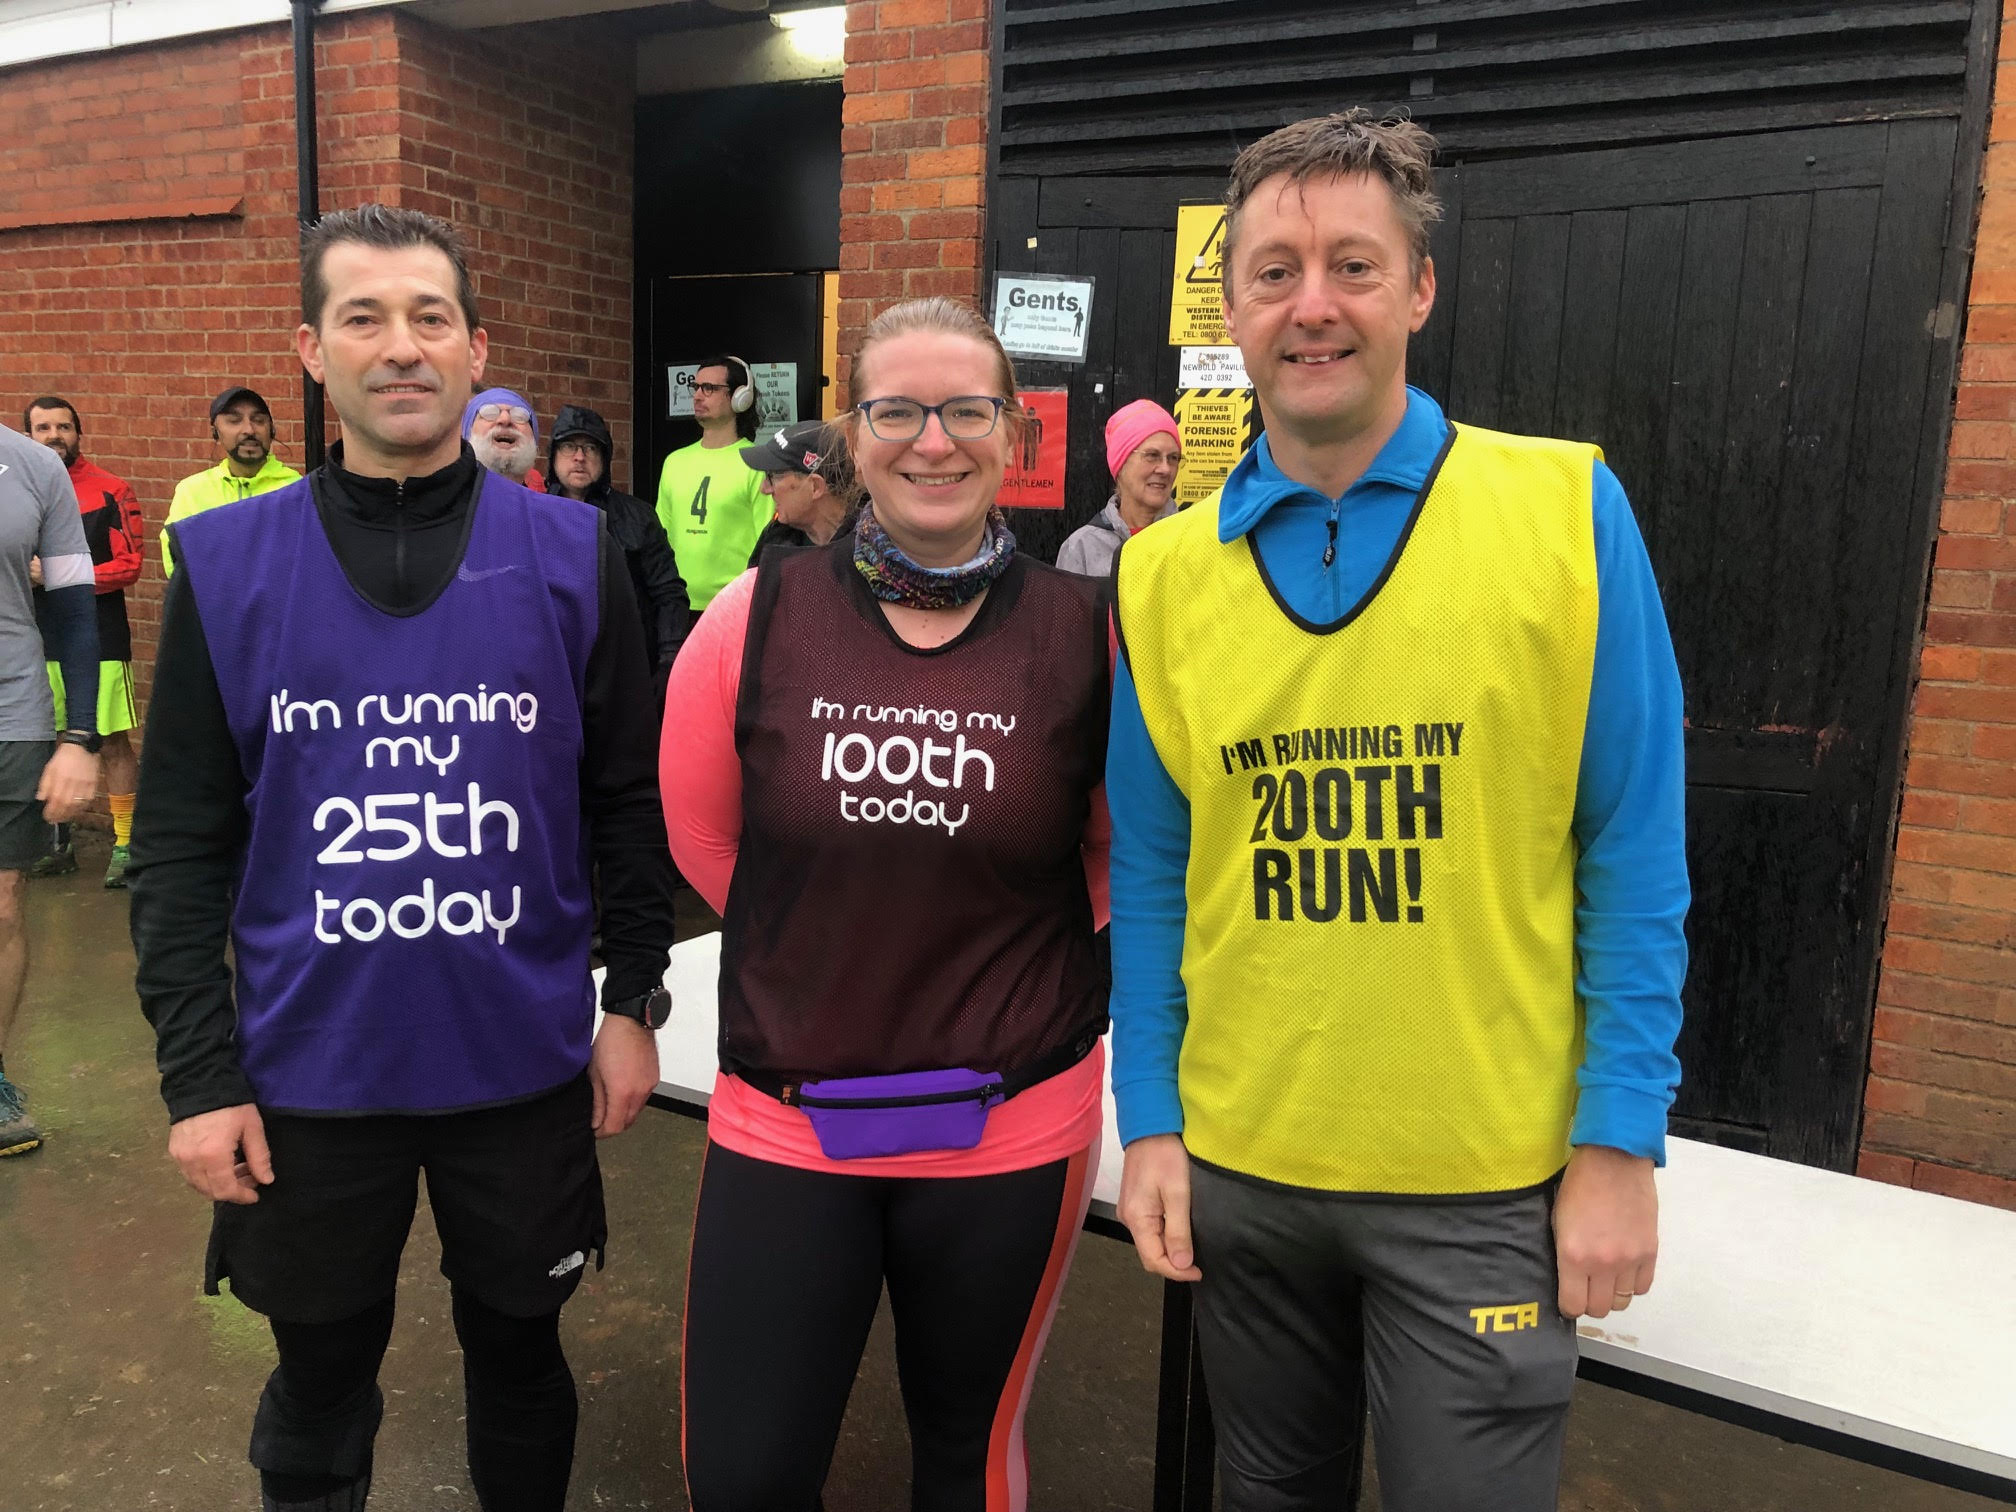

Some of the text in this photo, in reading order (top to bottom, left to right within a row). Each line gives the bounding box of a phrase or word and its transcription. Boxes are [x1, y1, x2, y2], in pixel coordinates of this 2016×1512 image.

[1008, 287, 1079, 312] Gents
[1216, 374, 1233, 382] 0392
[1220, 363, 1246, 371] PAVILIO
[1184, 426, 1237, 436] FORENSIC
[1185, 439, 1235, 448] MARKING
[690, 476, 711, 525] 4
[1002, 478, 1054, 488] GENTLEMEN
[271, 683, 538, 733] I'm running
[811, 697, 1015, 736] I'm running my
[365, 735, 460, 776] my
[821, 732, 995, 792] 100th
[1220, 722, 1464, 775] I'M RUNNING MY
[312, 781, 519, 864] 25th
[840, 790, 969, 836] today
[1249, 764, 1443, 844] 200TH
[1253, 847, 1424, 923] RUN!
[314, 877, 521, 945] today
[1469, 1301, 1539, 1334] TCA
